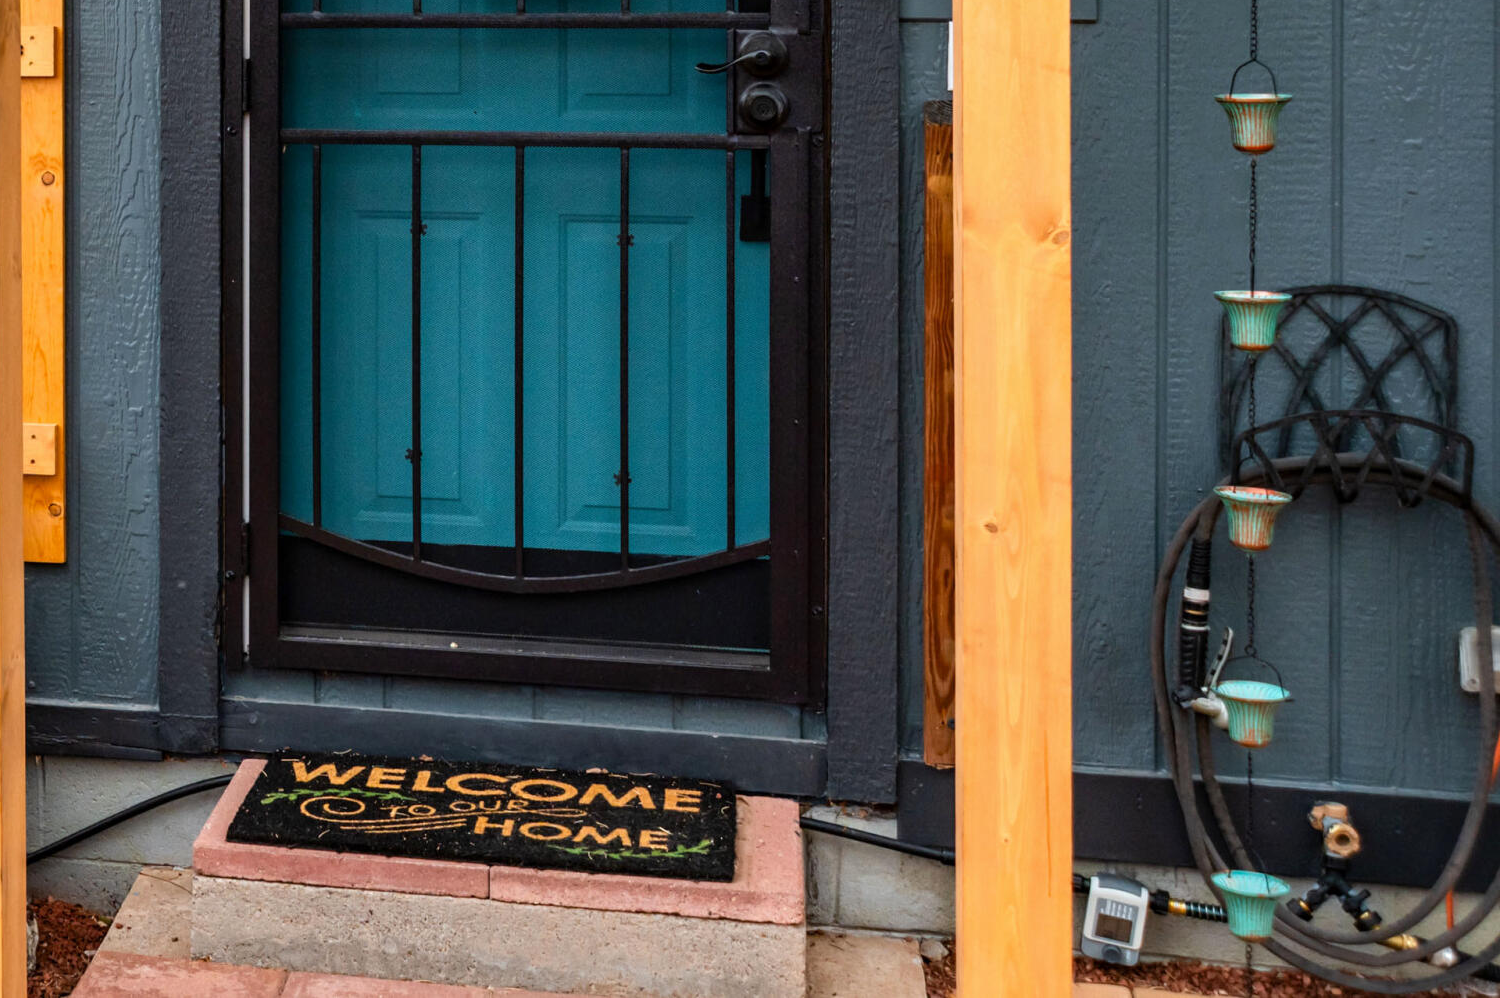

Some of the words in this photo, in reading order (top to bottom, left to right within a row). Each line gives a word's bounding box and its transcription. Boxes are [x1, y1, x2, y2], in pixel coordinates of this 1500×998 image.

[292, 761, 704, 813] WELCOME
[380, 804, 436, 819] TO
[449, 799, 530, 812] OUR
[473, 816, 669, 851] HOME
